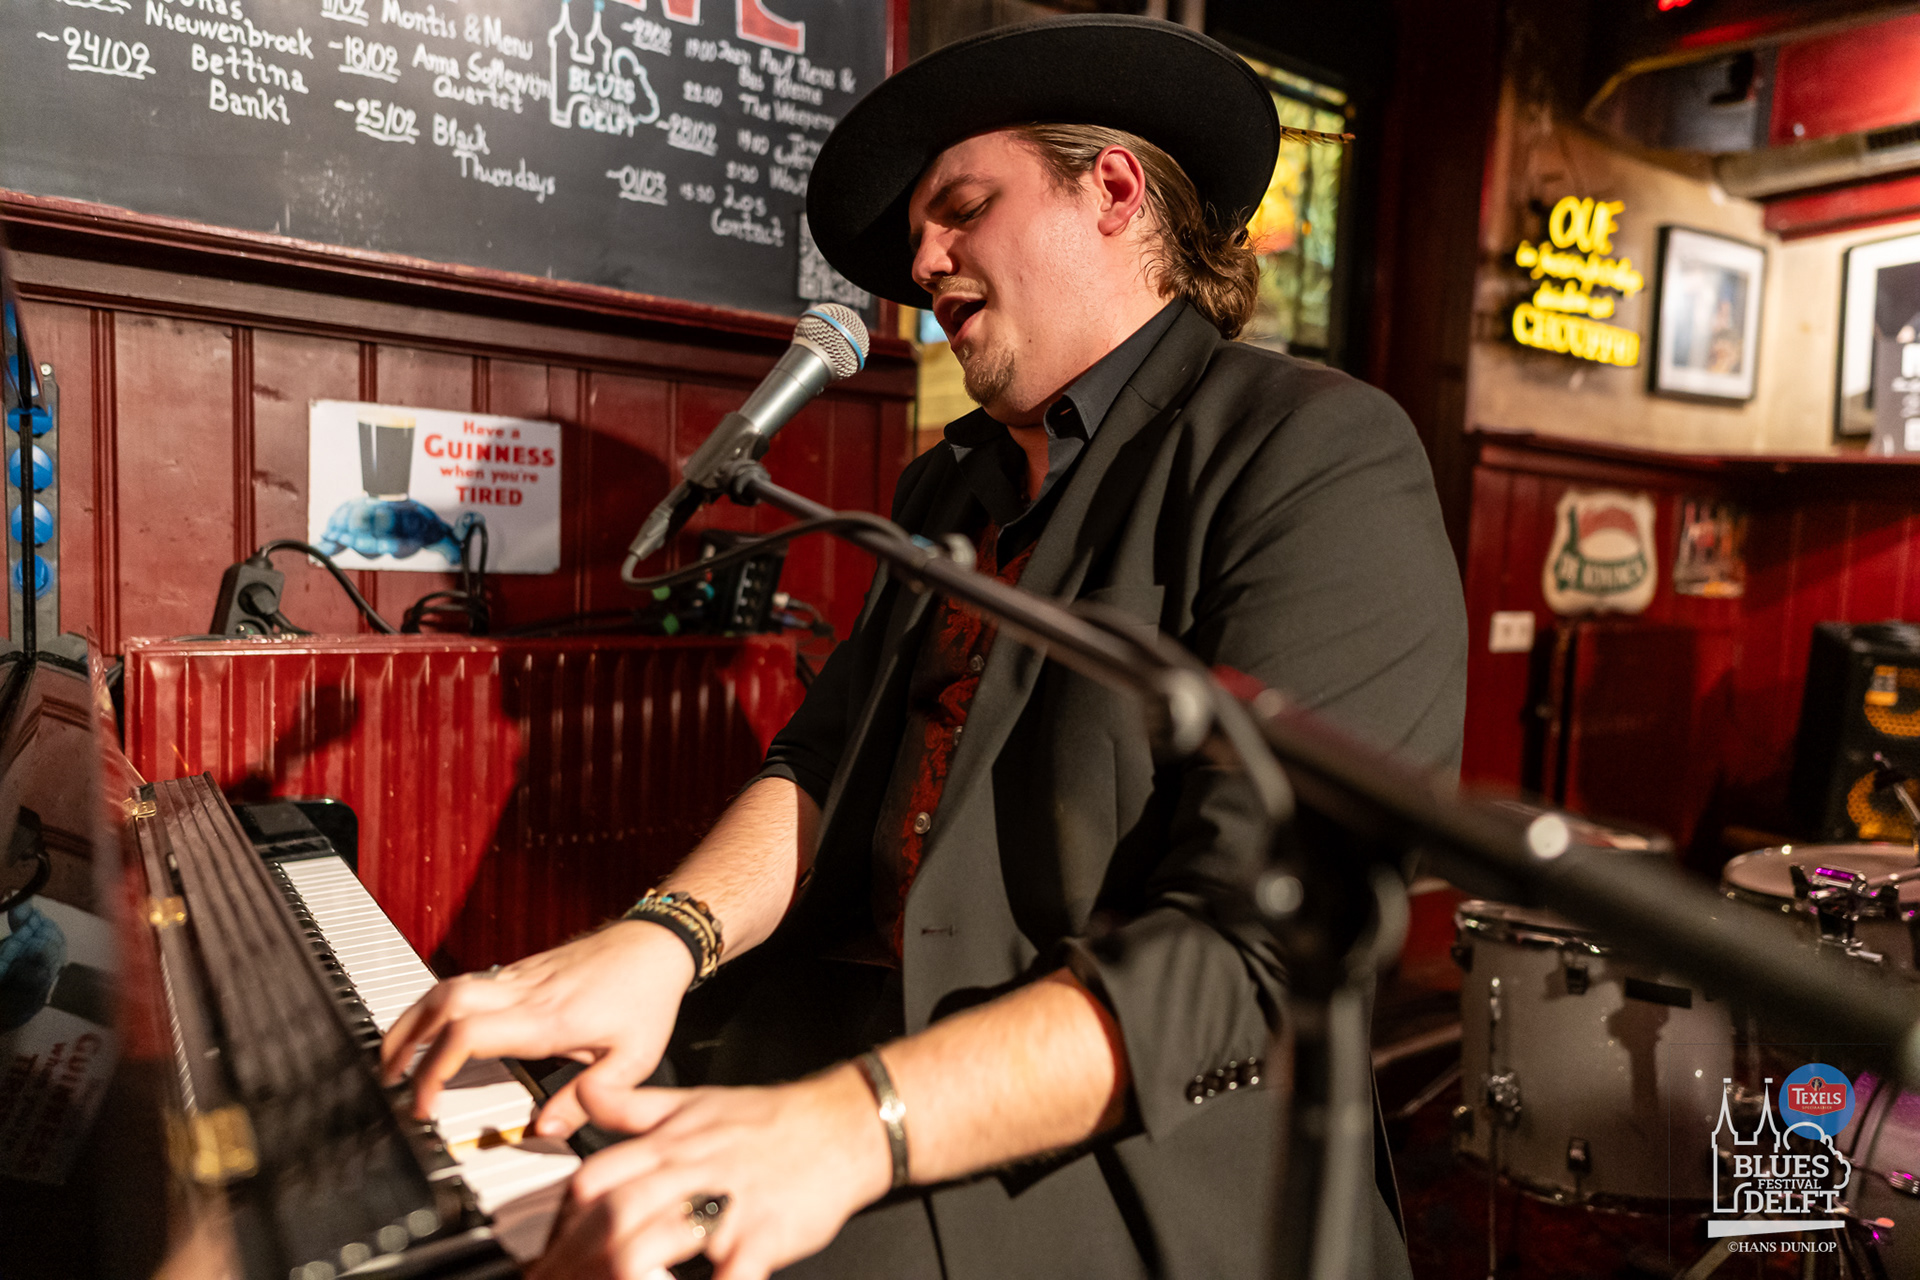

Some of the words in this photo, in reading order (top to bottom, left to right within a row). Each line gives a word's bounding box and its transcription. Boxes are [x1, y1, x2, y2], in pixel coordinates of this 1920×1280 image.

[145, 2, 315, 59] Nieuwenbroek
[191, 43, 309, 94] Bettina
[209, 77, 290, 125] Banki
[463, 421, 504, 438] Have
[511, 428, 520, 439] a
[424, 434, 555, 467] GUINNESS
[440, 464, 486, 480] when
[491, 469, 538, 484] you're
[456, 486, 523, 506] TIRED
